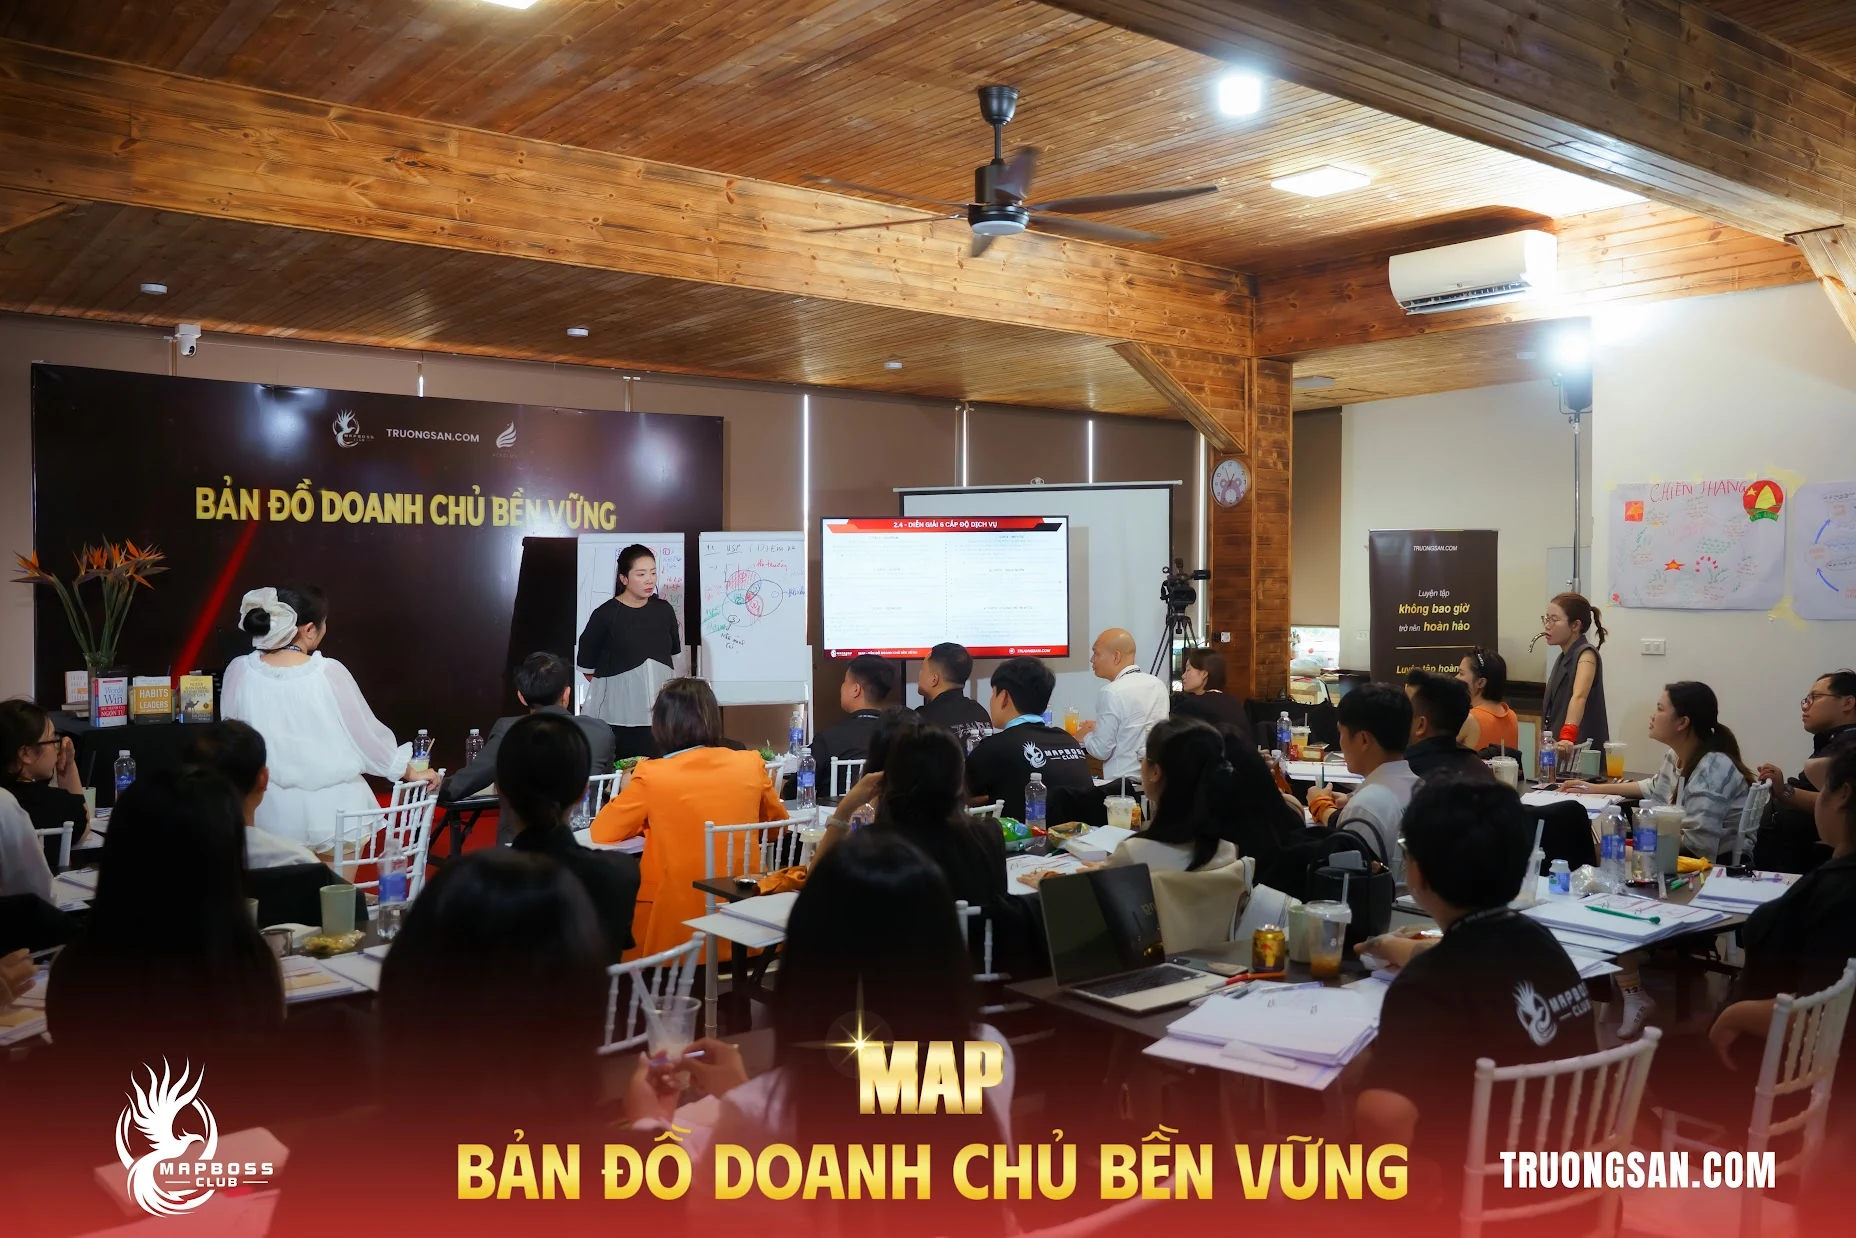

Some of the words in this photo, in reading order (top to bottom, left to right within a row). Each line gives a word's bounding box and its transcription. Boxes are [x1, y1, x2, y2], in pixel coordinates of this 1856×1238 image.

[386, 428, 480, 443] TRUONGSAN.COM
[196, 475, 260, 521] BẢN
[268, 478, 315, 523] ĐỒ
[321, 489, 424, 525] DOANH
[429, 484, 486, 527] CHỦ
[492, 486, 543, 527] BỀN
[548, 493, 617, 531] VỮNG
[908, 519, 924, 528] DIỄN
[925, 519, 939, 528] GIẢI
[959, 519, 970, 529] ĐỘ
[971, 521, 988, 529] DỊCH
[989, 521, 998, 529] VỤ
[1418, 590, 1438, 599] Luyện
[1439, 589, 1450, 599] tập
[1398, 603, 1429, 616] không
[1432, 604, 1451, 614] bao
[1453, 602, 1470, 616] giờ
[1399, 624, 1409, 632] trở
[1409, 624, 1421, 632] nên
[1423, 621, 1449, 632] hoàn
[1451, 620, 1470, 631] hảo
[1438, 663, 1459, 673] hoàn
[140, 688, 169, 699] HABITS
[104, 694, 123, 705] Win
[140, 700, 169, 709] LEADERS
